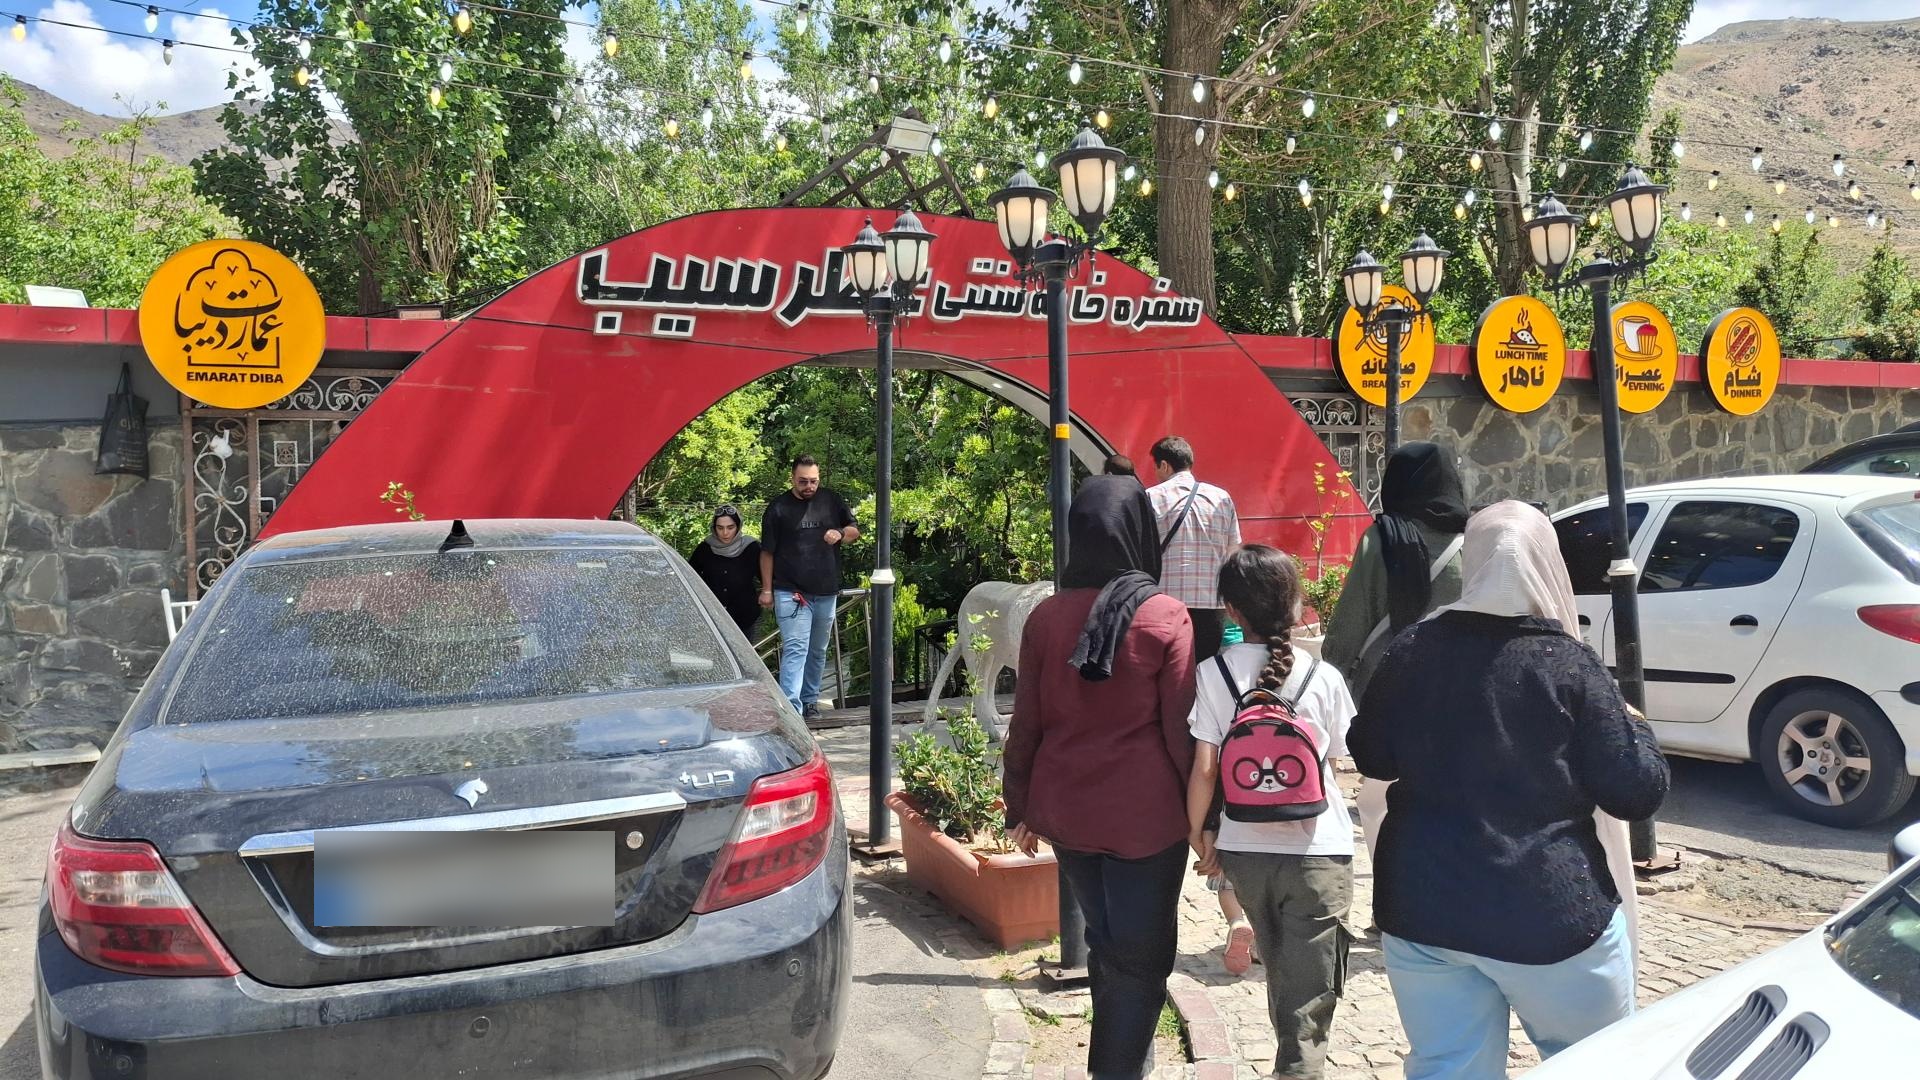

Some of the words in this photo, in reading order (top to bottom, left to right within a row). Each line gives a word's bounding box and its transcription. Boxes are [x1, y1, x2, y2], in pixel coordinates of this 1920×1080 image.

[580, 248, 781, 336] سیب
[774, 247, 932, 328] طر
[1028, 271, 1108, 324] خاه
[1110, 277, 1203, 333] سفره
[174, 292, 228, 353] دیبا
[201, 289, 284, 351] عمارت
[1361, 358, 1416, 378] صانه
[1495, 350, 1525, 360] LUNCH
[1526, 351, 1548, 361] TIME
[187, 371, 247, 383] EMARAT
[250, 372, 284, 384] DIBA
[1362, 380, 1411, 388] BREAST
[1498, 365, 1545, 394] ناهار
[1616, 363, 1662, 387] عصران
[1629, 382, 1665, 391] EVENING
[1724, 366, 1762, 396] شام
[1730, 389, 1762, 398] DINNER
